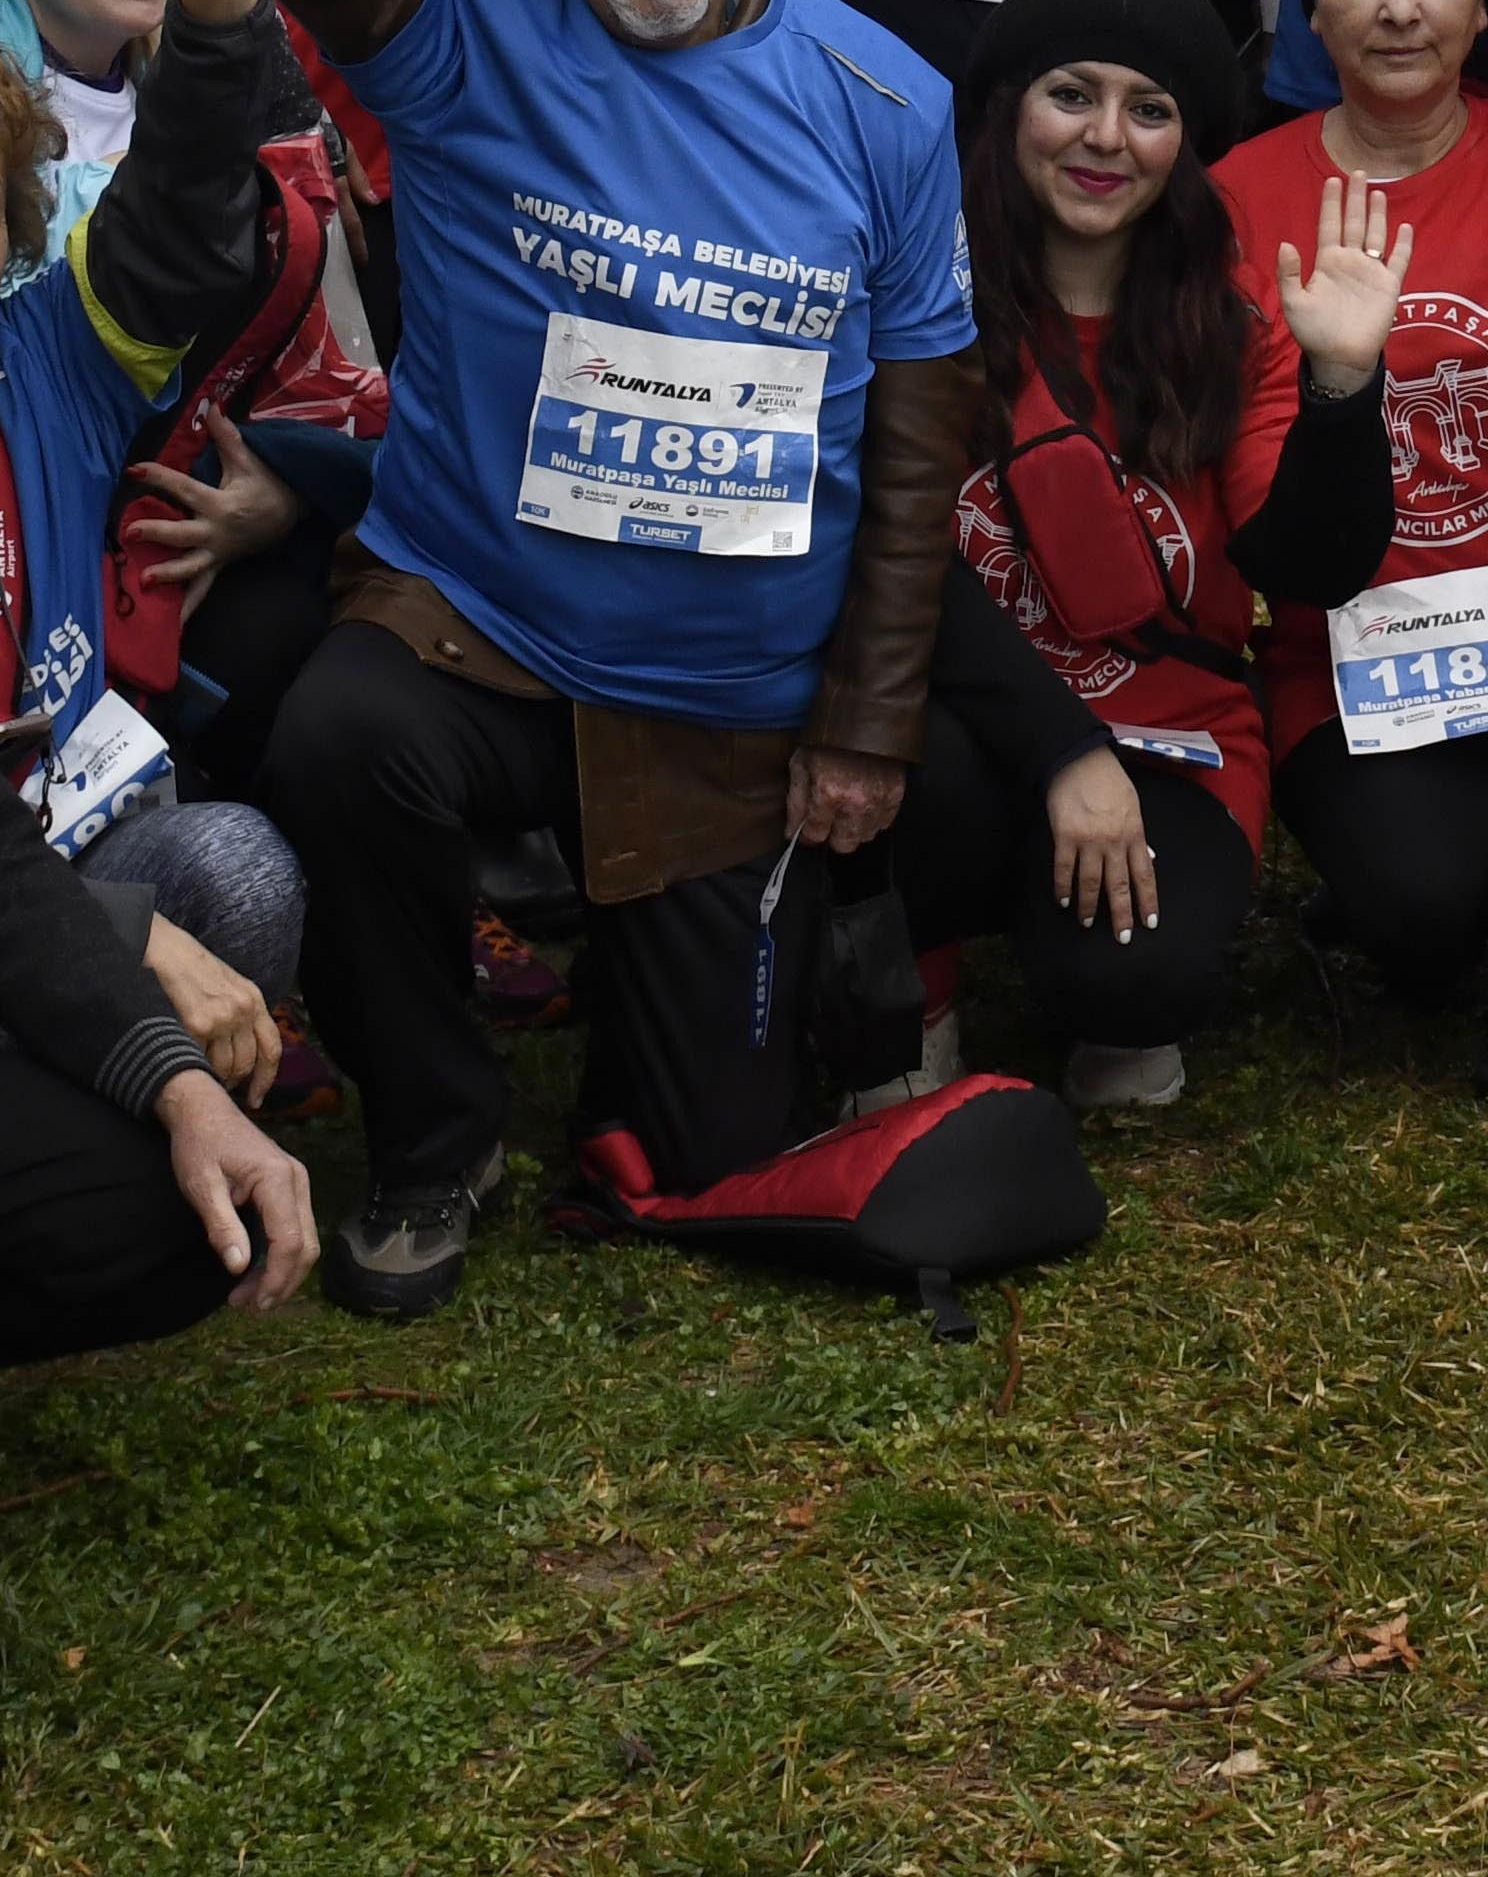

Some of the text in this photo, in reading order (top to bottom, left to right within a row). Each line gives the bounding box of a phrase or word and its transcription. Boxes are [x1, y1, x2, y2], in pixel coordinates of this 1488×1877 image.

[513, 192, 850, 295] MURATPAŞA BELEDİYESİ
[513, 226, 846, 340] YAŞLI MECLİSİ
[600, 372, 712, 403] RUNTALYA
[756, 397, 797, 408] ANTALYA
[567, 410, 774, 480] 11891
[550, 452, 789, 500] Muratpaşa Yaşlı Meclisi
[1386, 608, 1485, 635] RUNTALYA
[1357, 693, 1442, 715] Muratpaşa
[93, 740, 130, 777] ANTALYA
